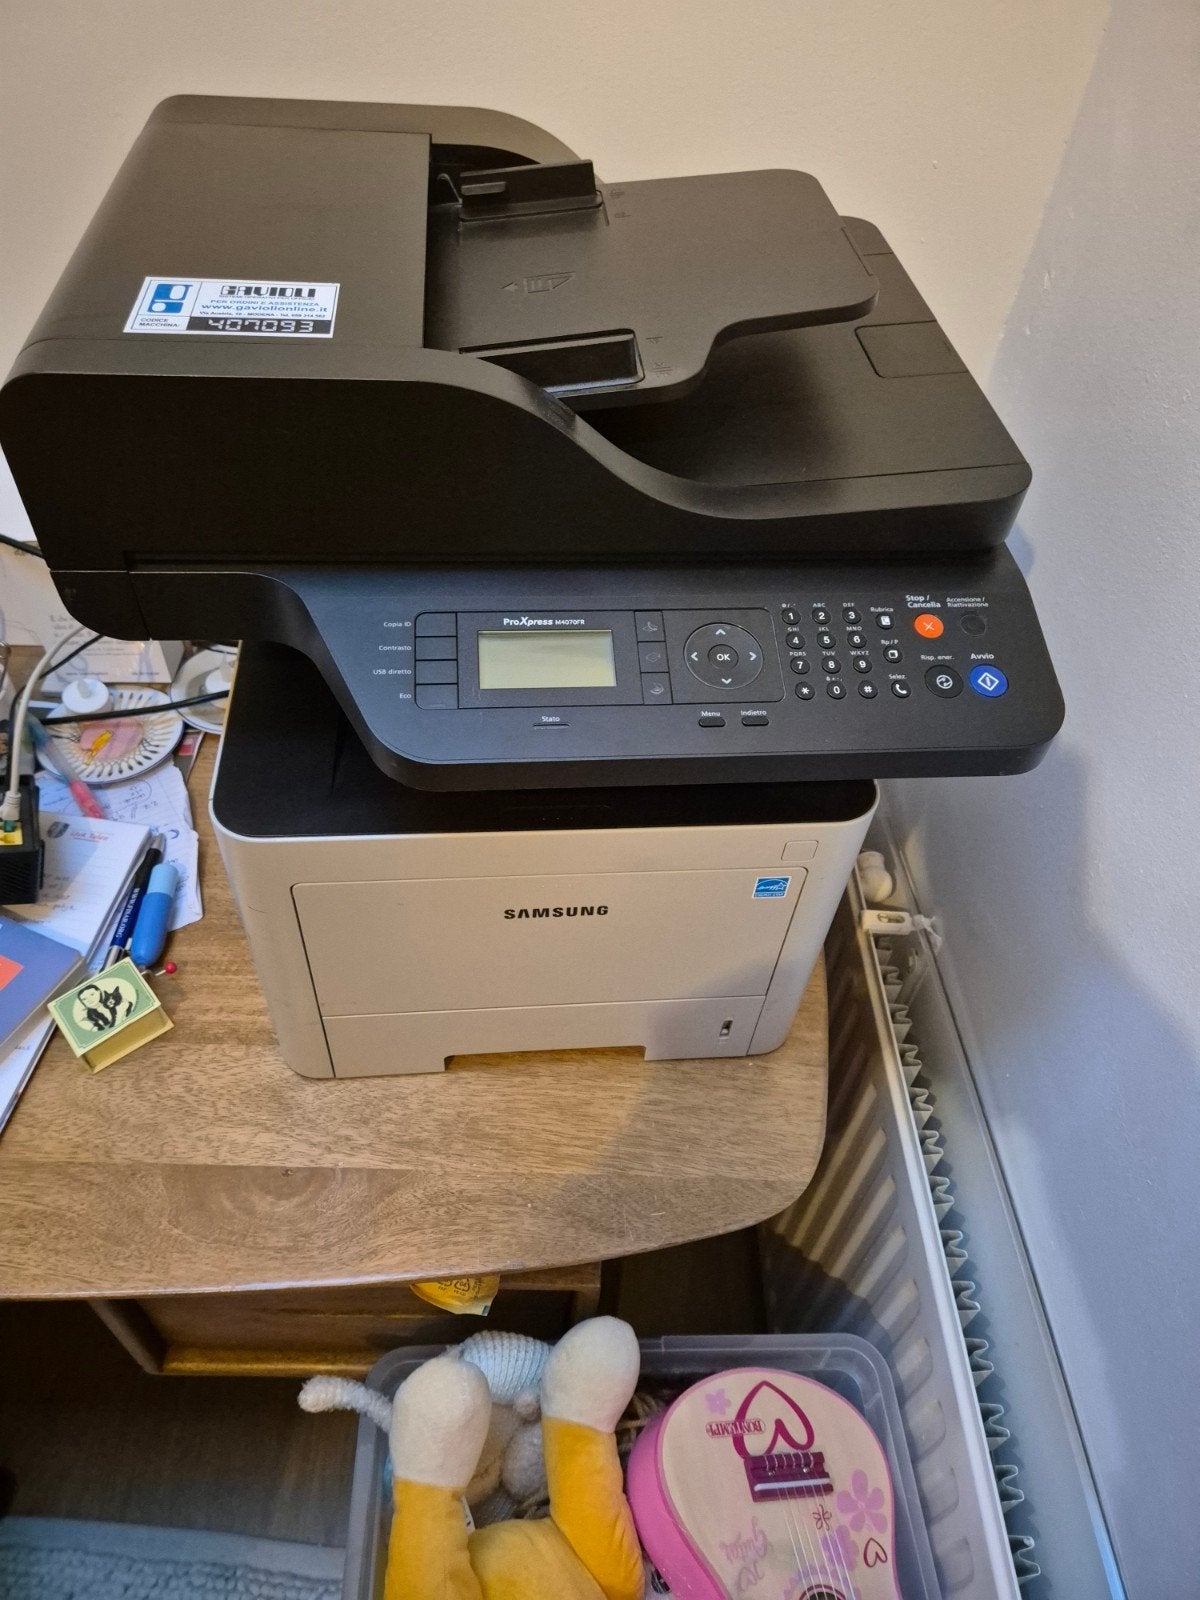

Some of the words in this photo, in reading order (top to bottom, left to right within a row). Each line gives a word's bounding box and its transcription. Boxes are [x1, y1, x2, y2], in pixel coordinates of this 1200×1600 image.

[220, 285, 316, 297] GAVIOLI
[201, 303, 328, 313] www.gaviolionline.it
[208, 319, 314, 333] 407093
[788, 612, 794, 620] 1
[818, 612, 826, 620] 2
[848, 611, 856, 620] 3
[383, 621, 404, 629] Copia
[503, 616, 553, 627] ProXpress
[792, 636, 799, 644] 4
[823, 636, 831, 644] 5
[853, 635, 860, 644] 6
[378, 644, 412, 652] Contrasto
[716, 653, 731, 661] OK
[970, 652, 995, 660] Avvio
[797, 661, 804, 670] 7
[828, 660, 835, 669] 8
[859, 660, 867, 668] 9
[833, 686, 840, 694] 0
[399, 692, 412, 700] Eco
[503, 905, 609, 920] SAMSUNG
[706, 1419, 763, 1437] BONTEMPI
